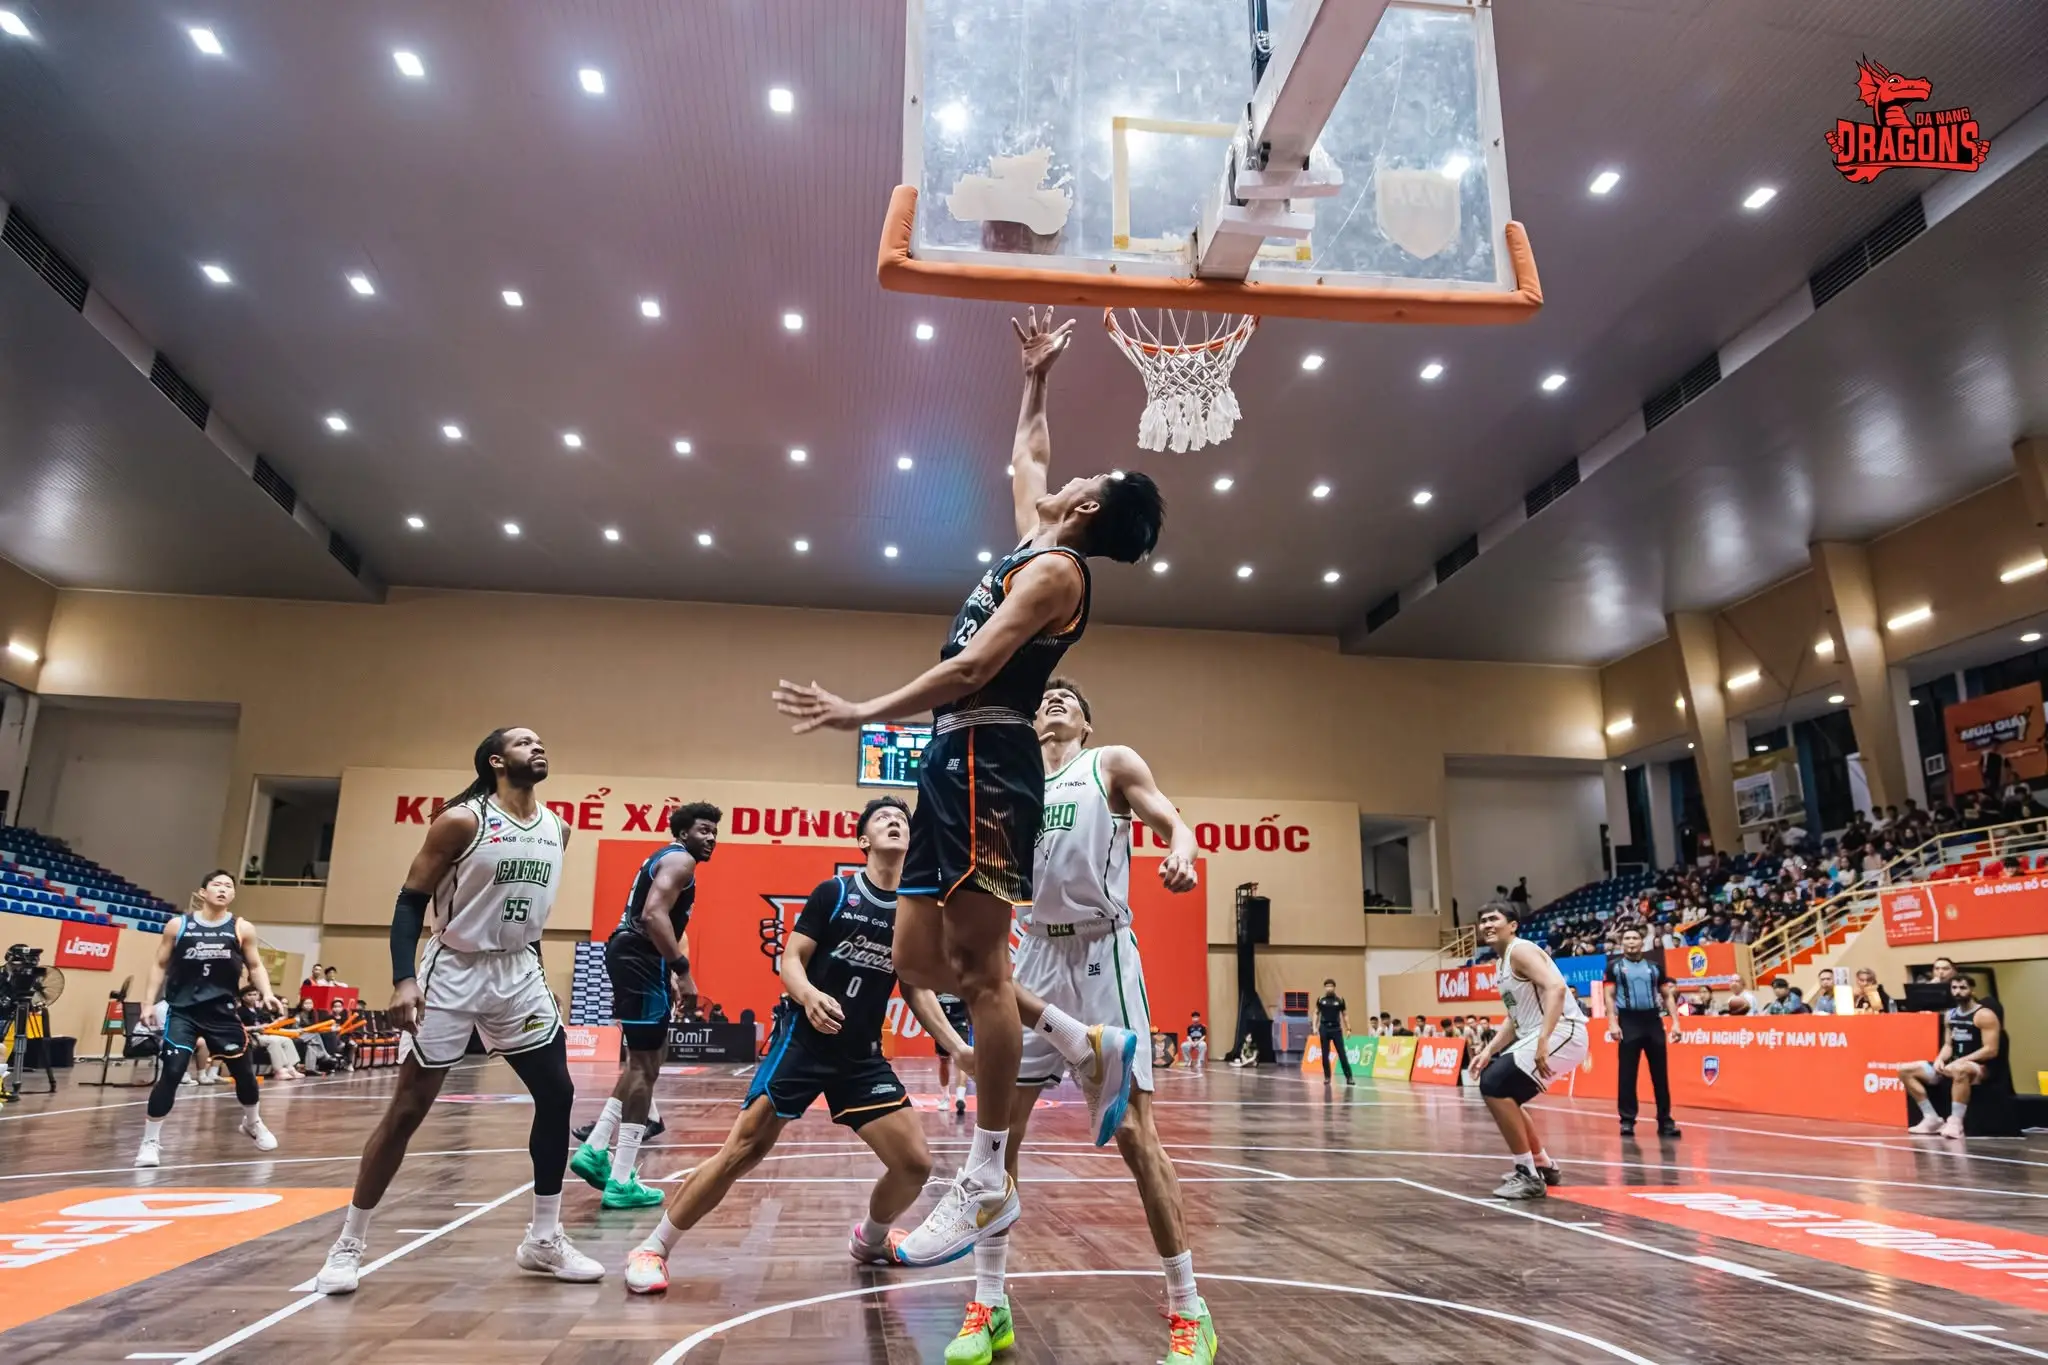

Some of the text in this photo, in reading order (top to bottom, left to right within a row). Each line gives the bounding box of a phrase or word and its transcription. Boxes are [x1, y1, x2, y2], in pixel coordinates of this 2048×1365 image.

[1195, 813, 1310, 853] QUỐC
[503, 898, 531, 922] 55
[871, 918, 888, 929] Grab
[203, 963, 211, 977] 5
[846, 976, 862, 998] 0
[1756, 1028, 1785, 1050] VIỆT
[1786, 1031, 1816, 1047] NAM
[1818, 1031, 1848, 1048] VBA
[1435, 1047, 1458, 1069] MSB
